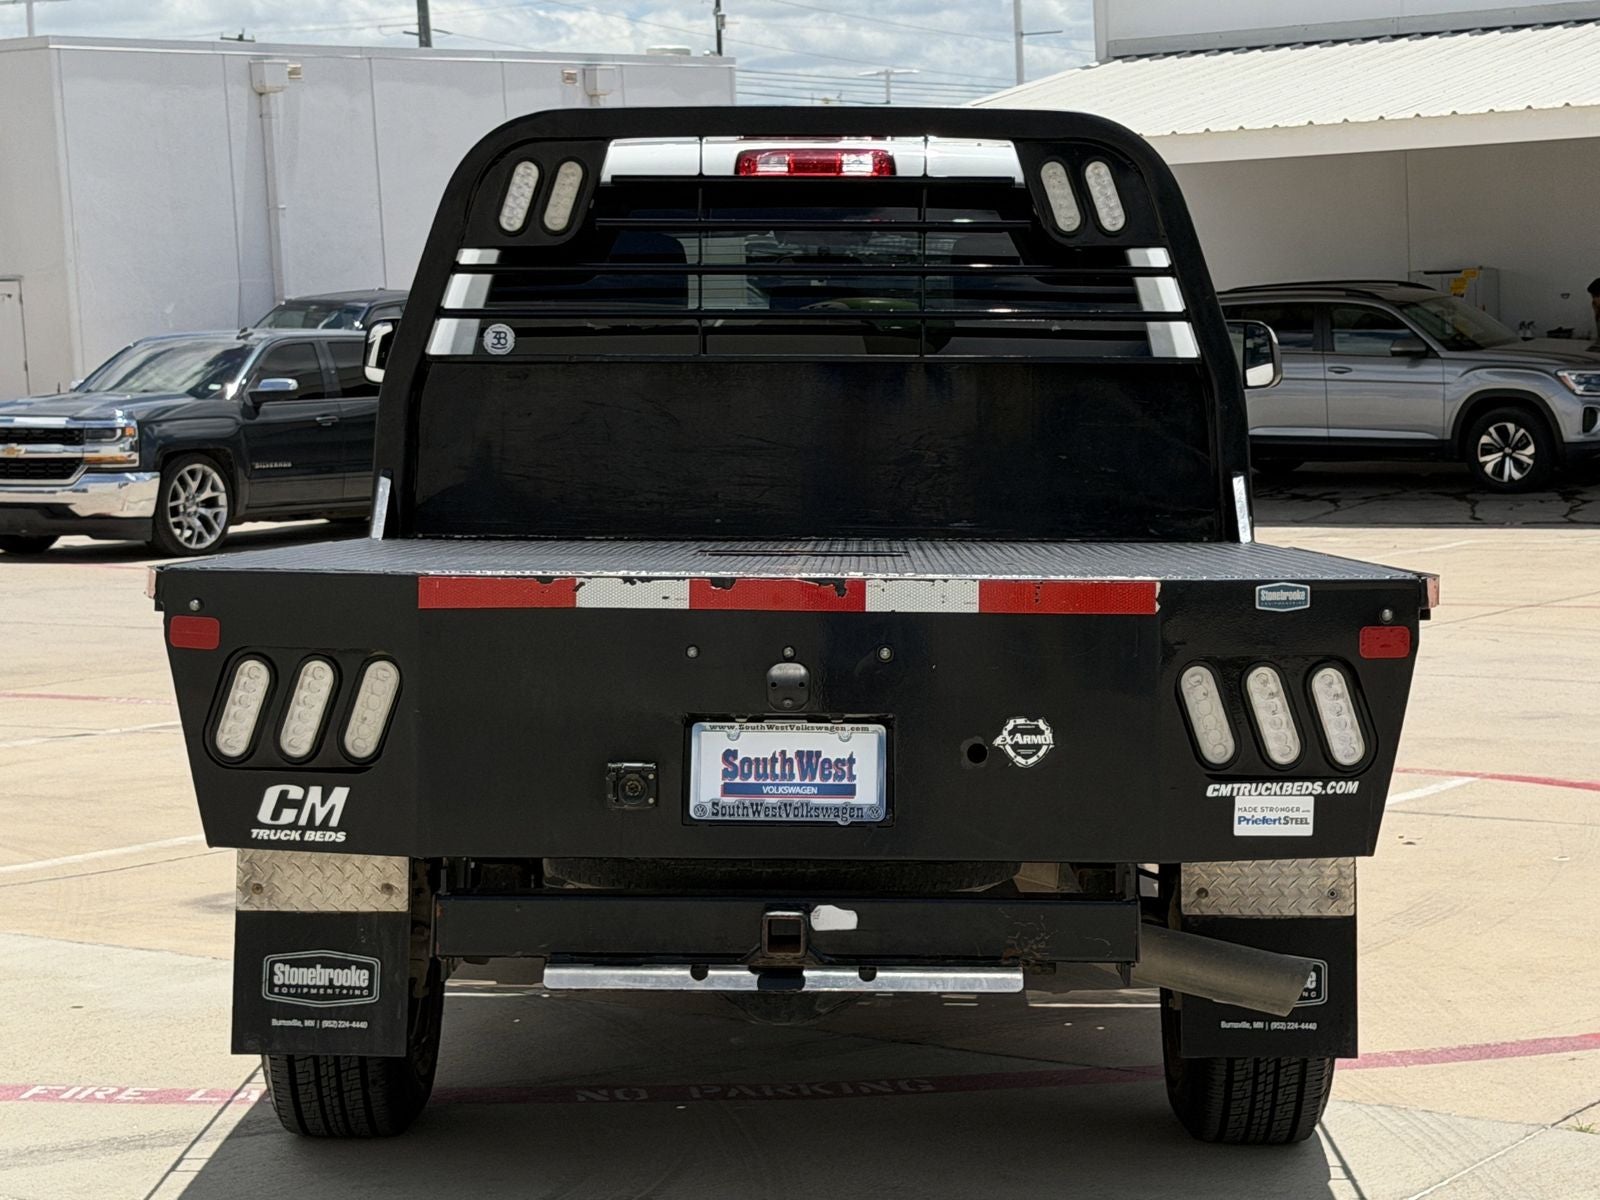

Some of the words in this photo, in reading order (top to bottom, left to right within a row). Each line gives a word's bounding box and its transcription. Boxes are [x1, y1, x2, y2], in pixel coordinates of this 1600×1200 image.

[1260, 589, 1306, 601] Stonebrooke
[721, 748, 857, 782] SouthWest
[762, 785, 818, 795] VOLKSWAGEN
[1206, 780, 1360, 798] CMTRUCKBEDS.COM
[256, 784, 350, 828] CM
[711, 801, 865, 822] SouthWestVolkswagen
[250, 828, 302, 841] TRUCK
[304, 830, 347, 843] BEDS
[273, 962, 370, 988] Stonebrooke
[273, 986, 341, 995] EQUIPMENT
[18, 1084, 162, 1101] FIRE
[184, 1087, 262, 1101] LA
[575, 1087, 649, 1102] NO
[688, 1078, 937, 1100] PARKING
